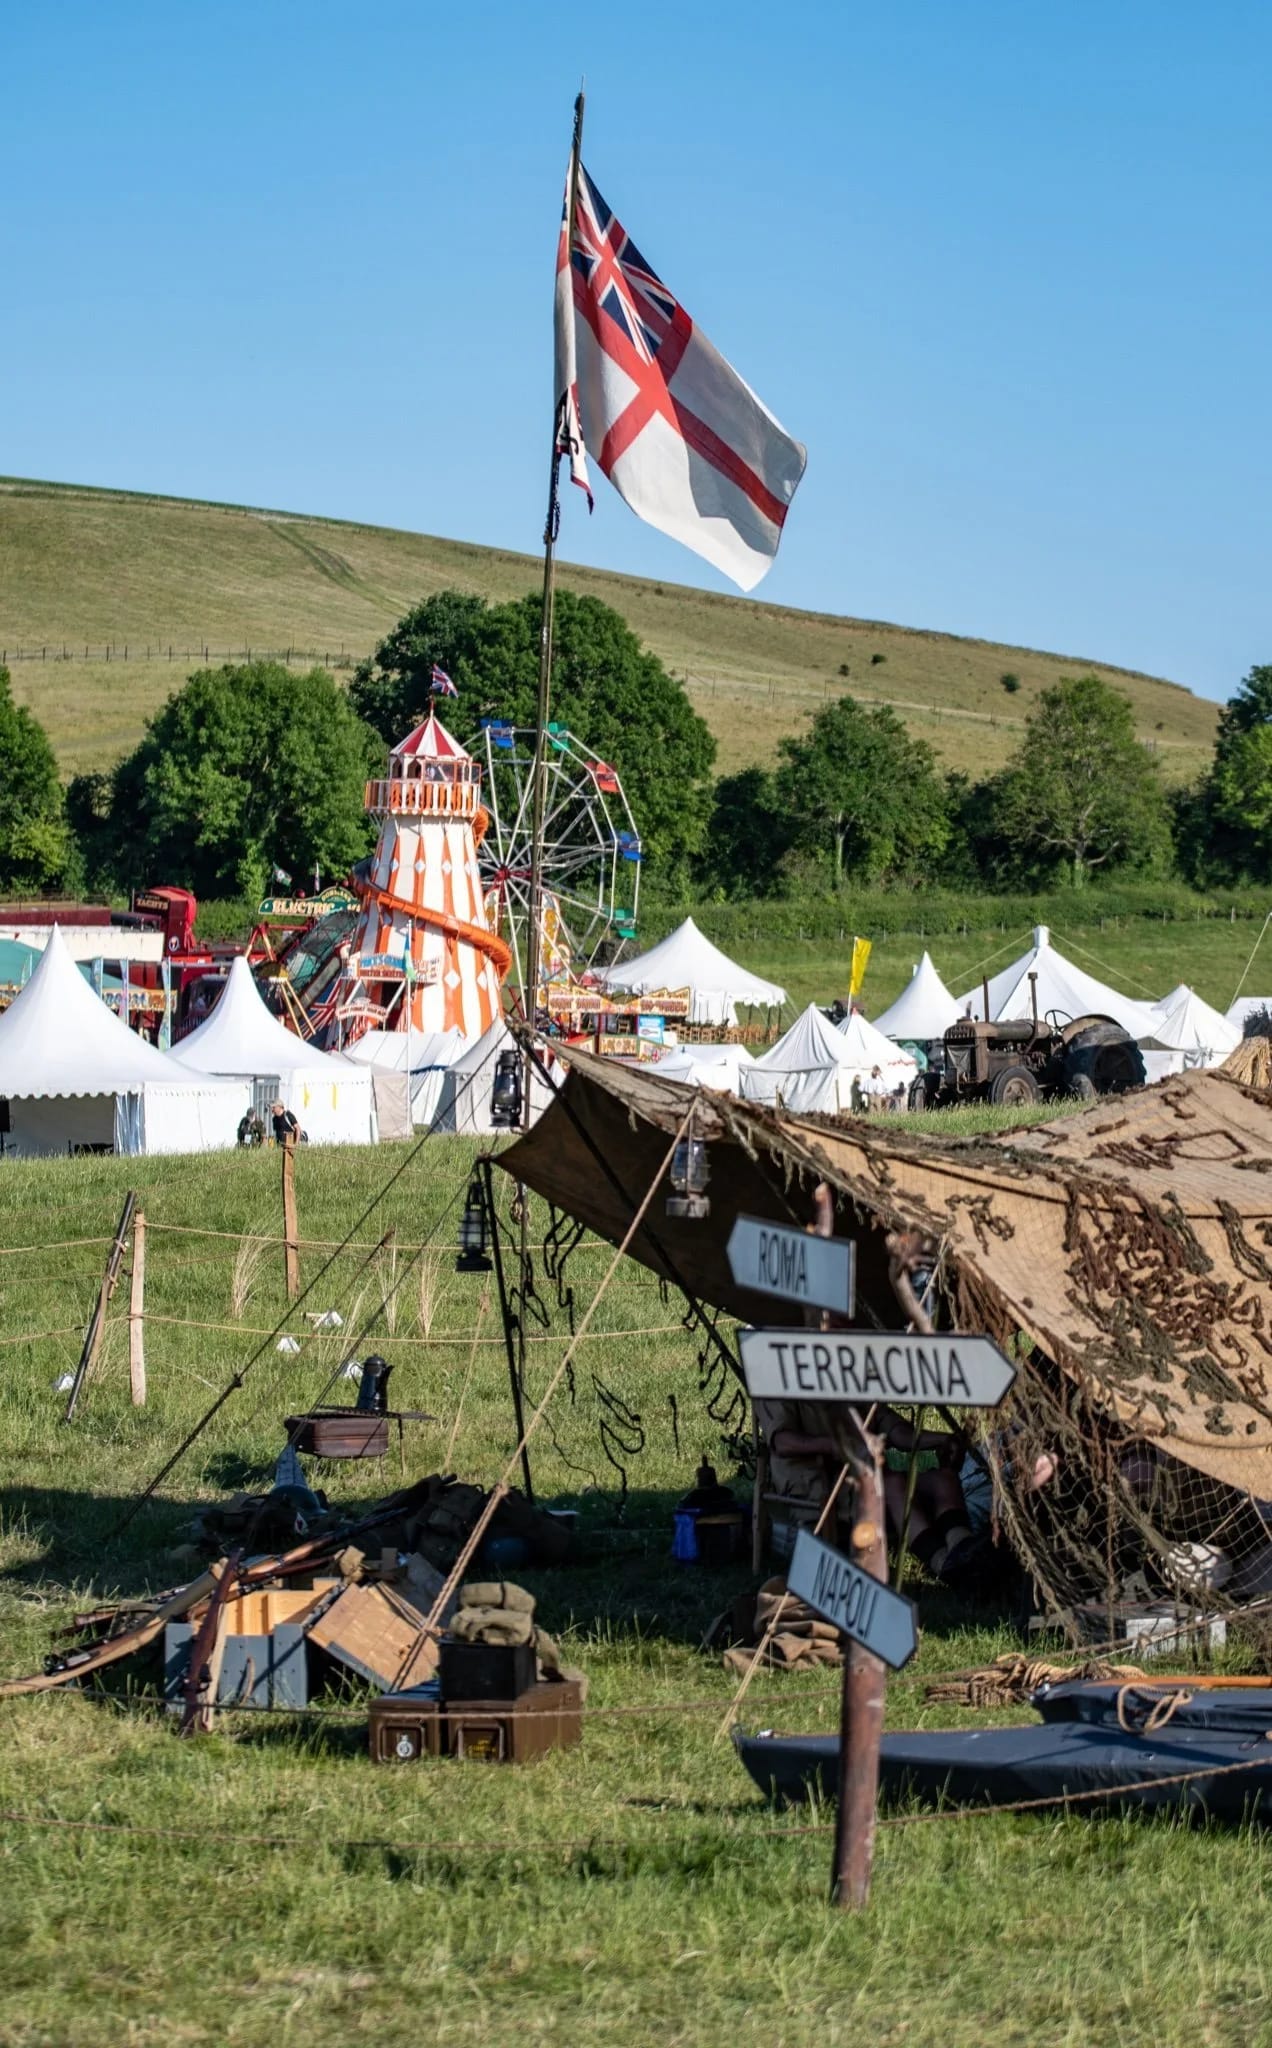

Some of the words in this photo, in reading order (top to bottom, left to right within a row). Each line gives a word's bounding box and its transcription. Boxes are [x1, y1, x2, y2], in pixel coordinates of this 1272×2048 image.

[758, 1230, 808, 1296] ROMA
[768, 1342, 971, 1398] TERRACINA
[811, 1551, 880, 1639] NAPOLI
